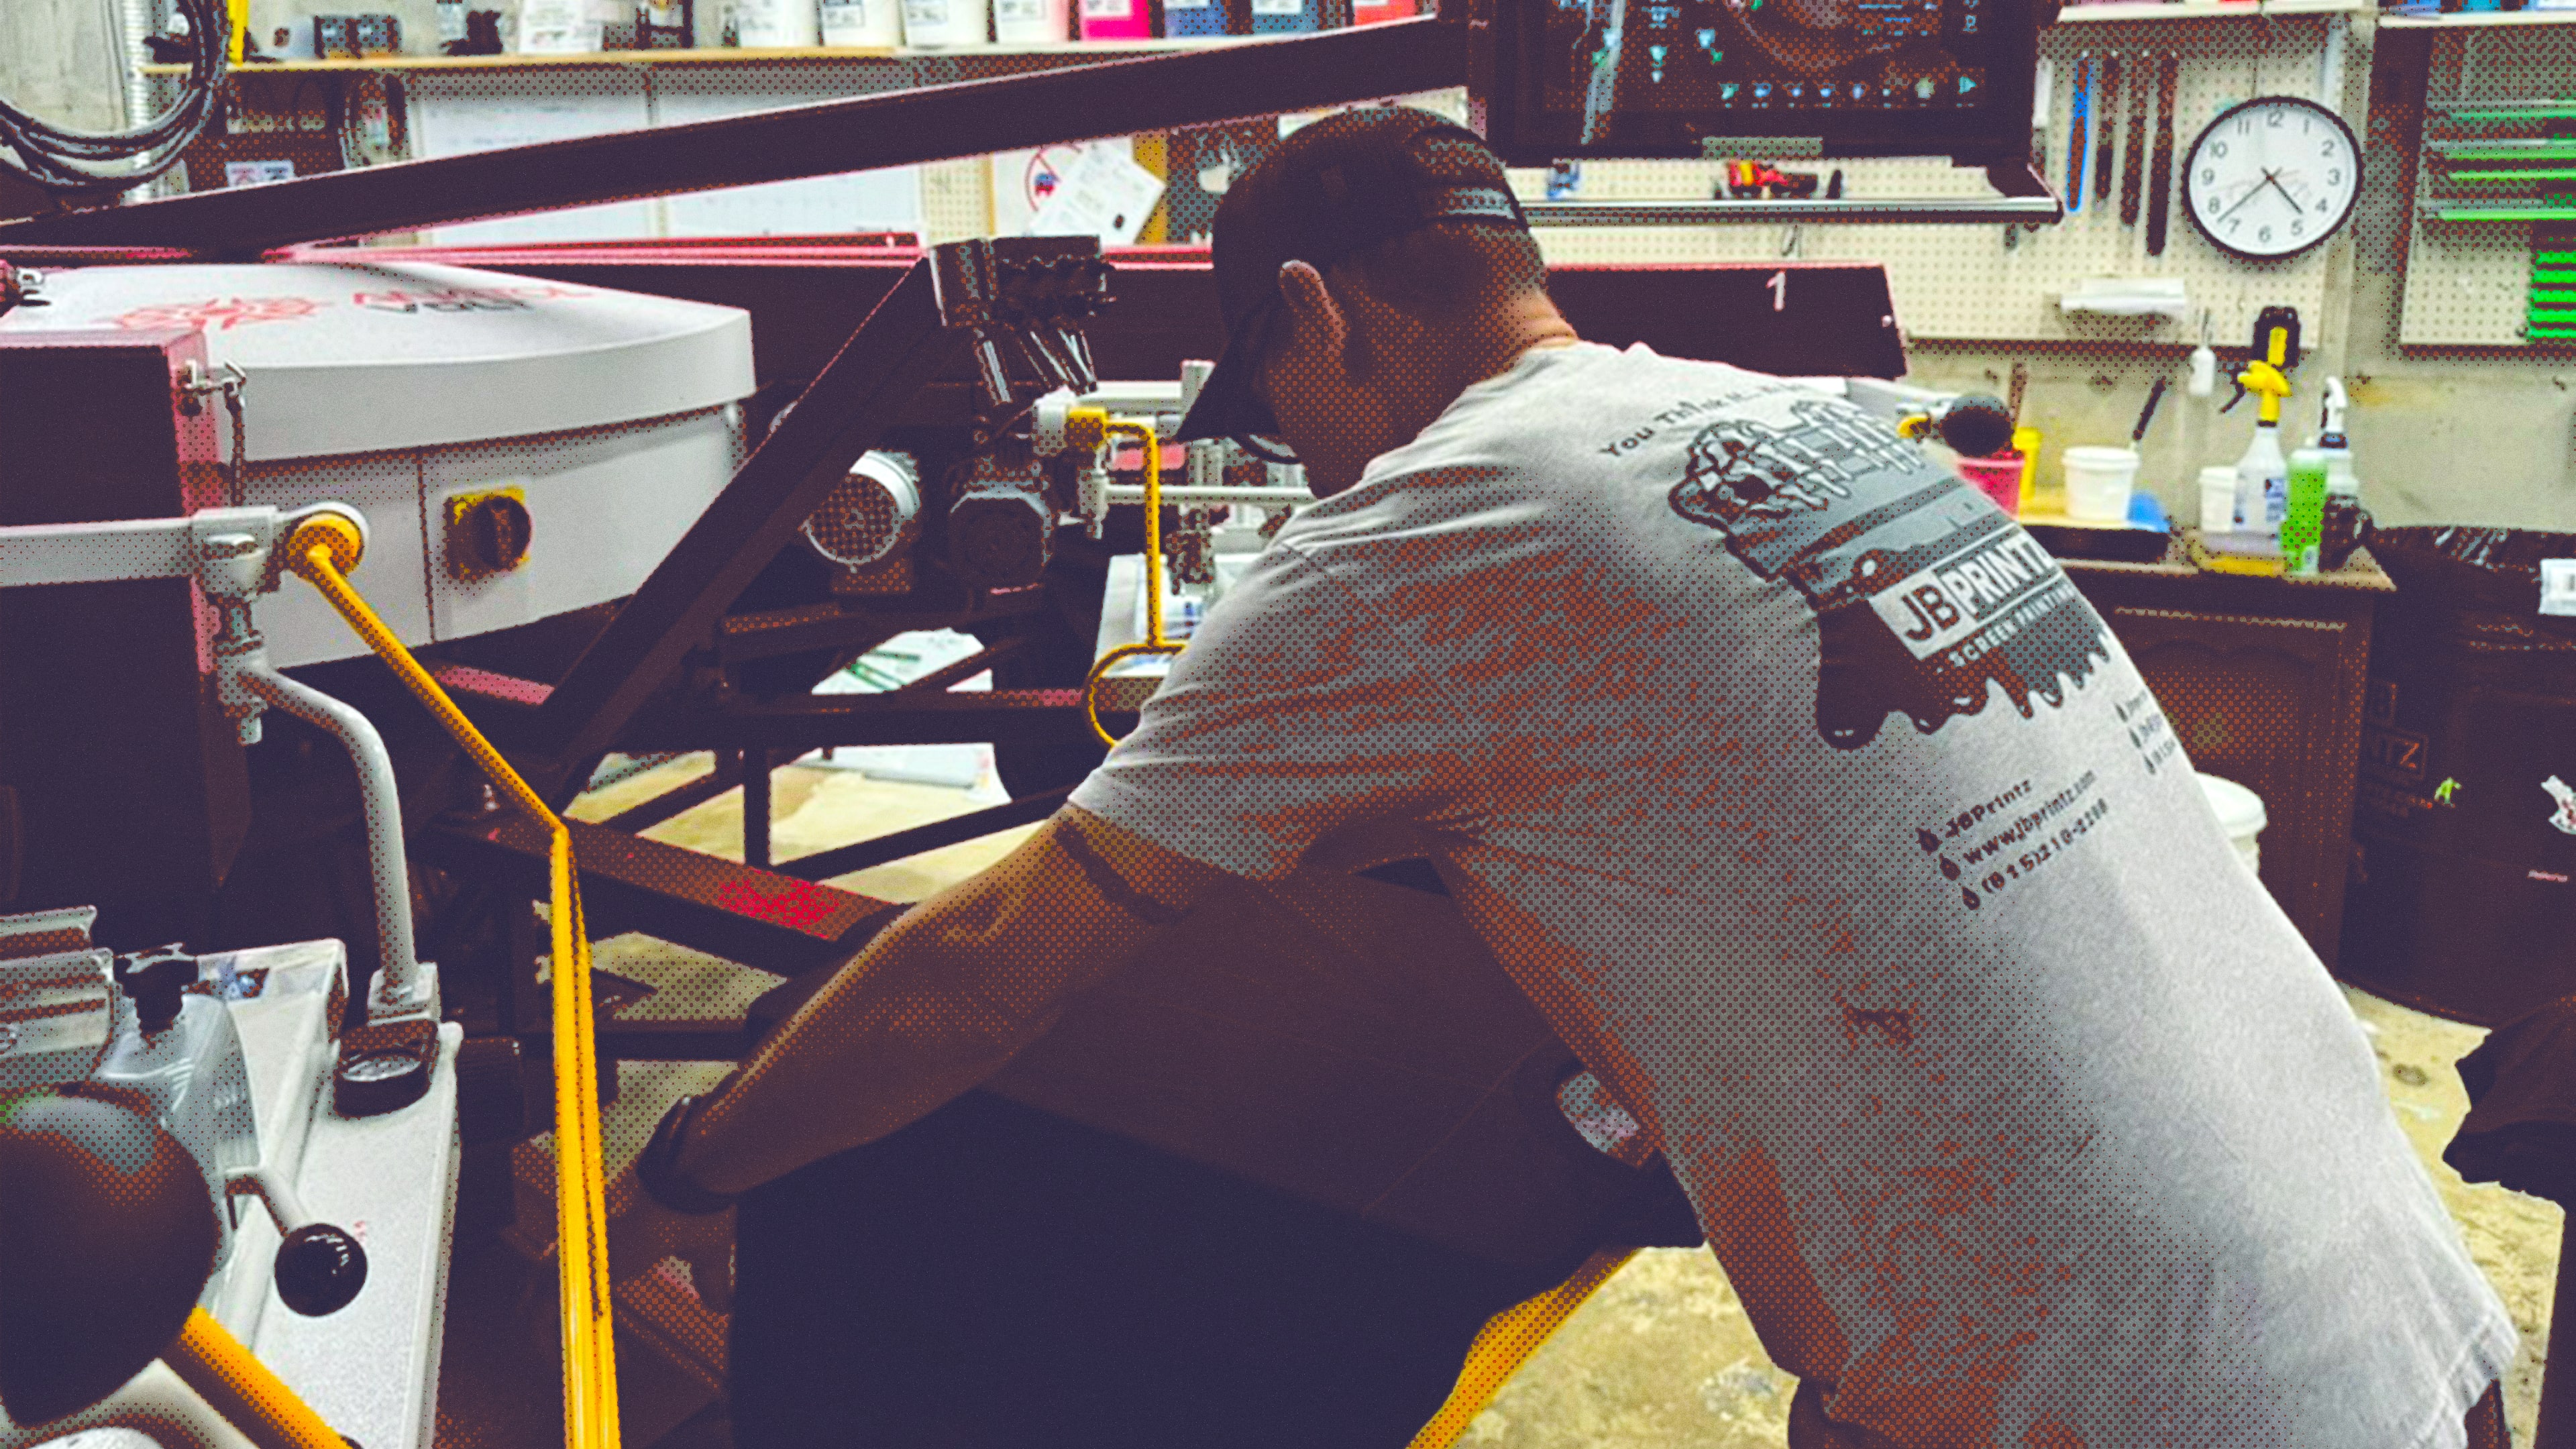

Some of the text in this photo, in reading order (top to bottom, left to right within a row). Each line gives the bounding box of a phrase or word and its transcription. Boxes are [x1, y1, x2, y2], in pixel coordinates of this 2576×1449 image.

[2237, 117, 2250, 135] 11
[2267, 109, 2284, 128] 12
[2304, 117, 2310, 134] 1
[2210, 140, 2229, 158] 10
[2321, 139, 2335, 157] 2
[2201, 168, 2215, 186] 9
[2327, 168, 2341, 186] 3
[2208, 196, 2220, 214] 8
[2314, 197, 2328, 213] 4
[2229, 218, 2241, 233] 7
[2257, 225, 2271, 243] 6
[2290, 218, 2304, 236] 5
[1766, 270, 1786, 312] 1
